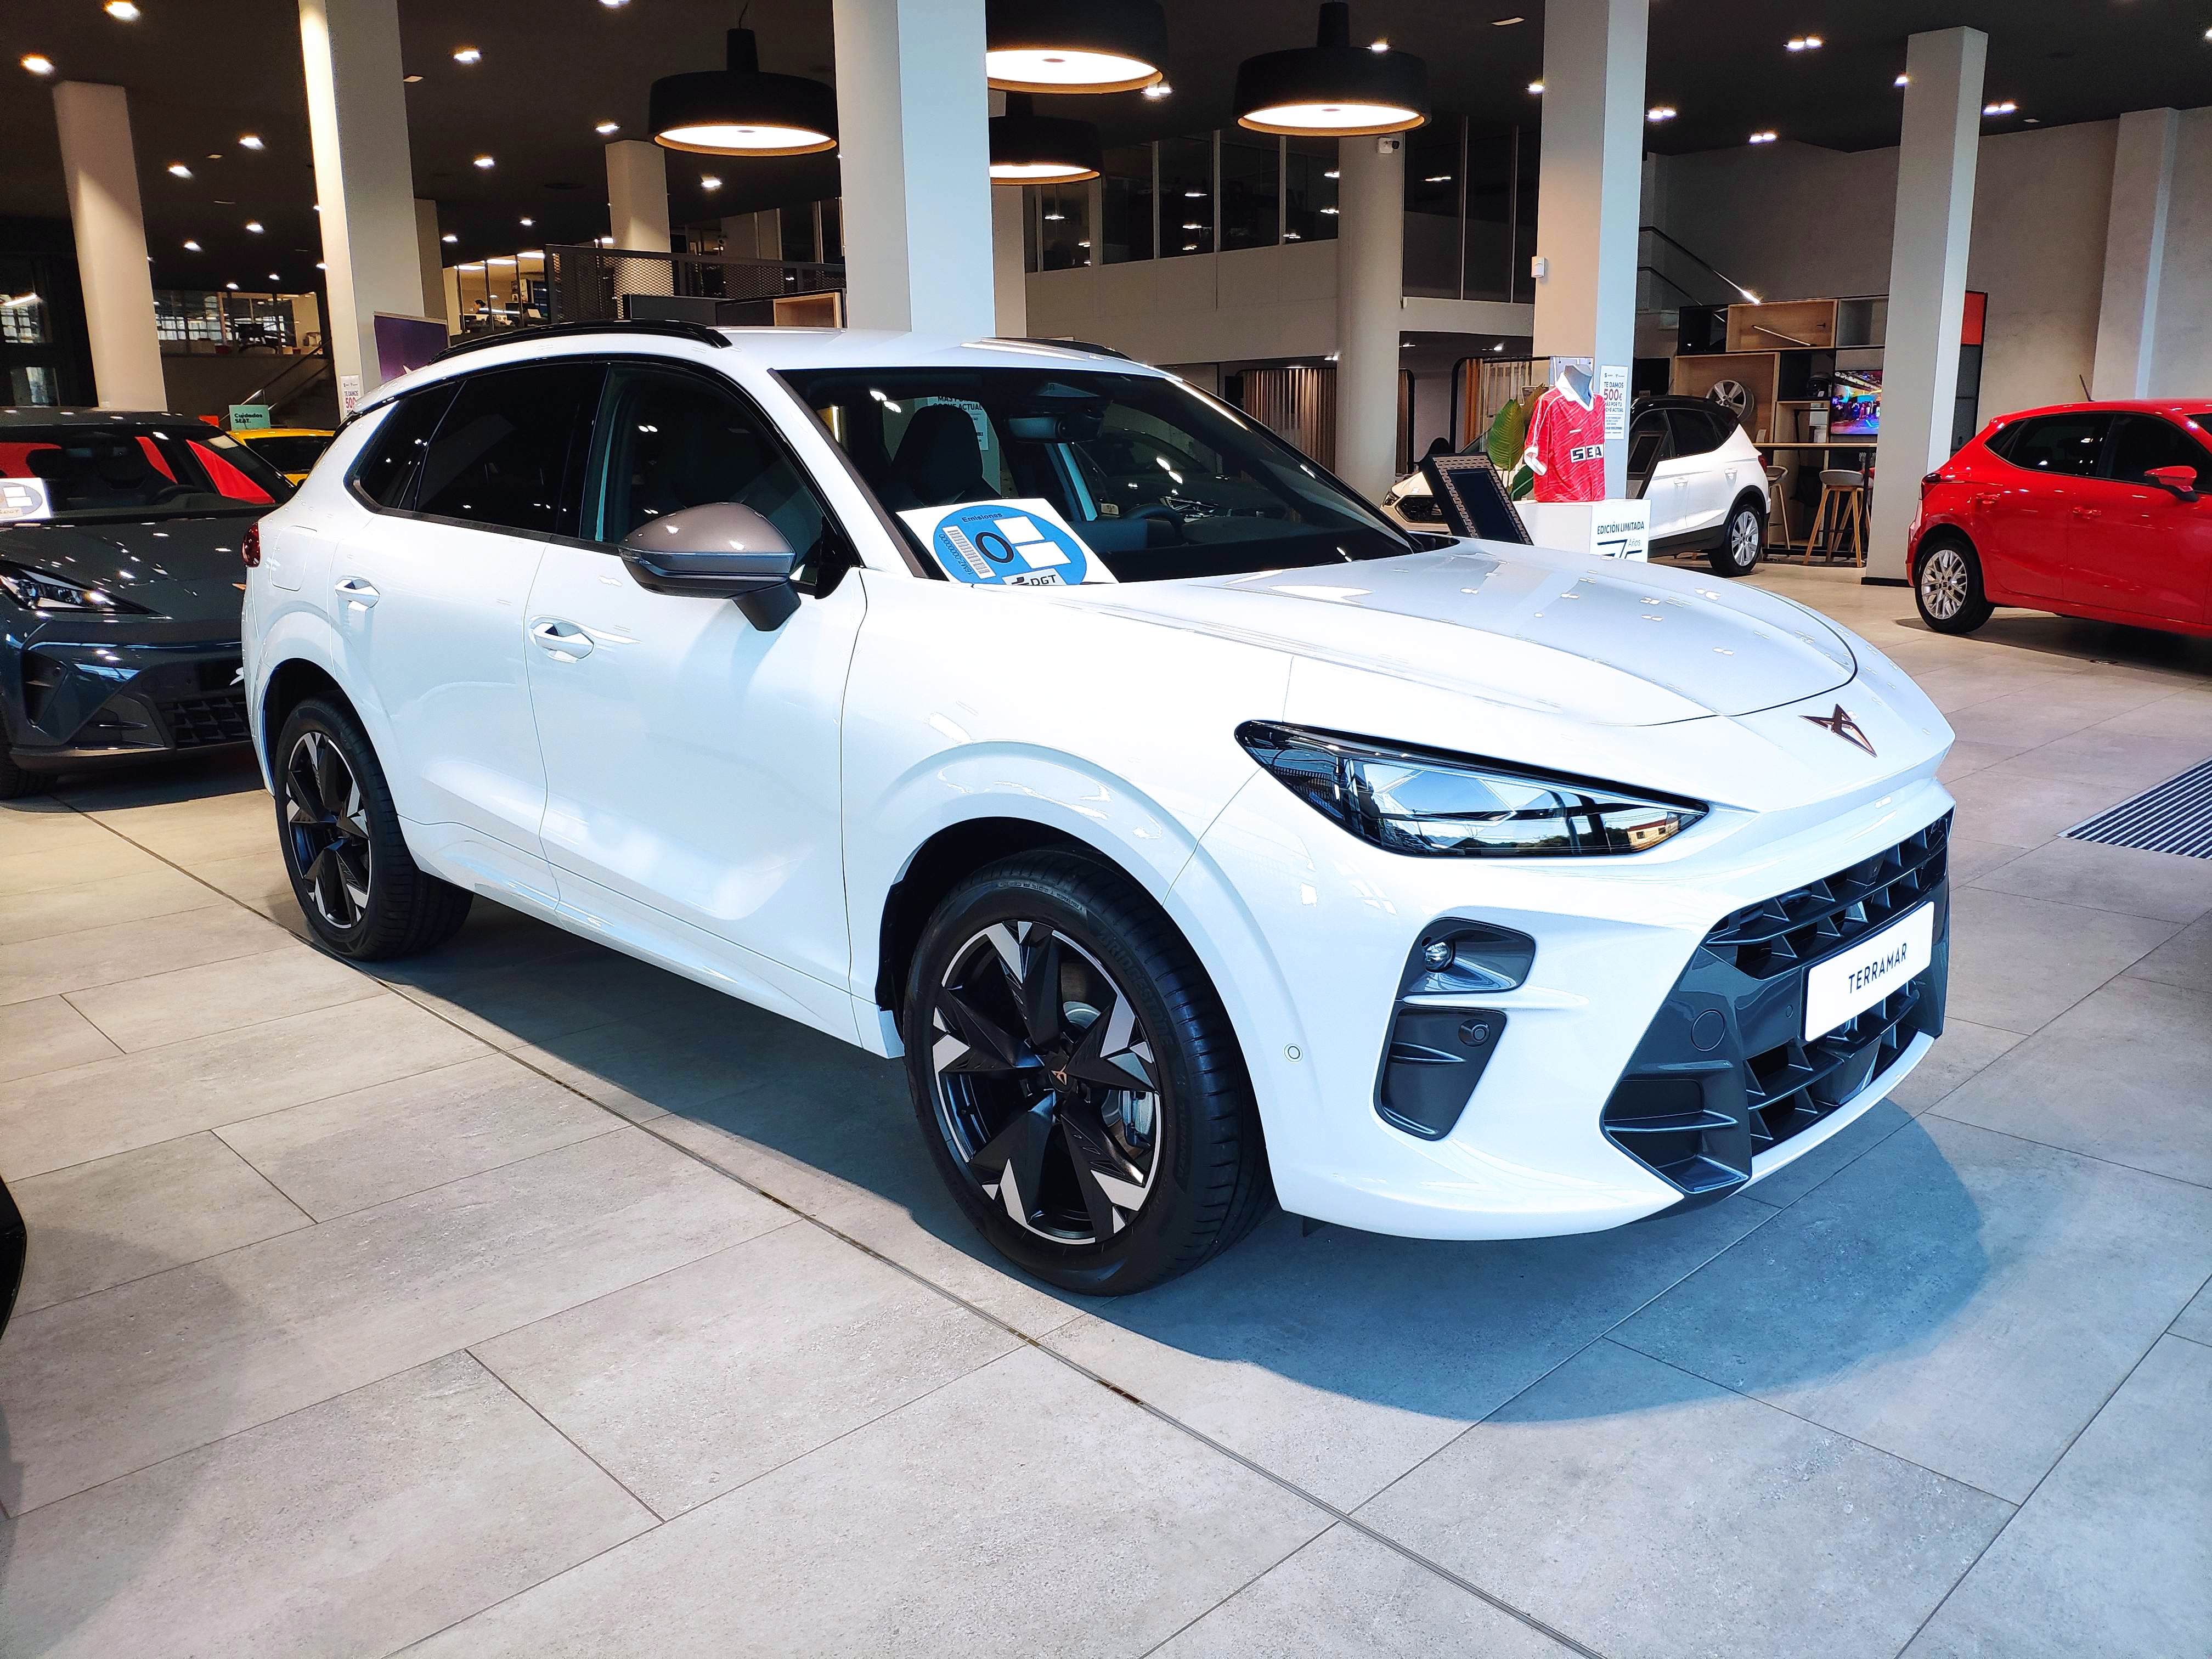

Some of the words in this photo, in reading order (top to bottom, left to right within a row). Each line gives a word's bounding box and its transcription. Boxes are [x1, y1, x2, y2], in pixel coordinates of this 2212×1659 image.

[1604, 389, 1622, 401] 500€
[961, 513, 1003, 522] Emisiones
[1597, 521, 1620, 535] EDICIÓN
[1620, 521, 1645, 532] LIMITADA
[1628, 538, 1641, 548] Años
[1030, 574, 1056, 586] DGT
[1848, 942, 1908, 994] TERRAMAR
